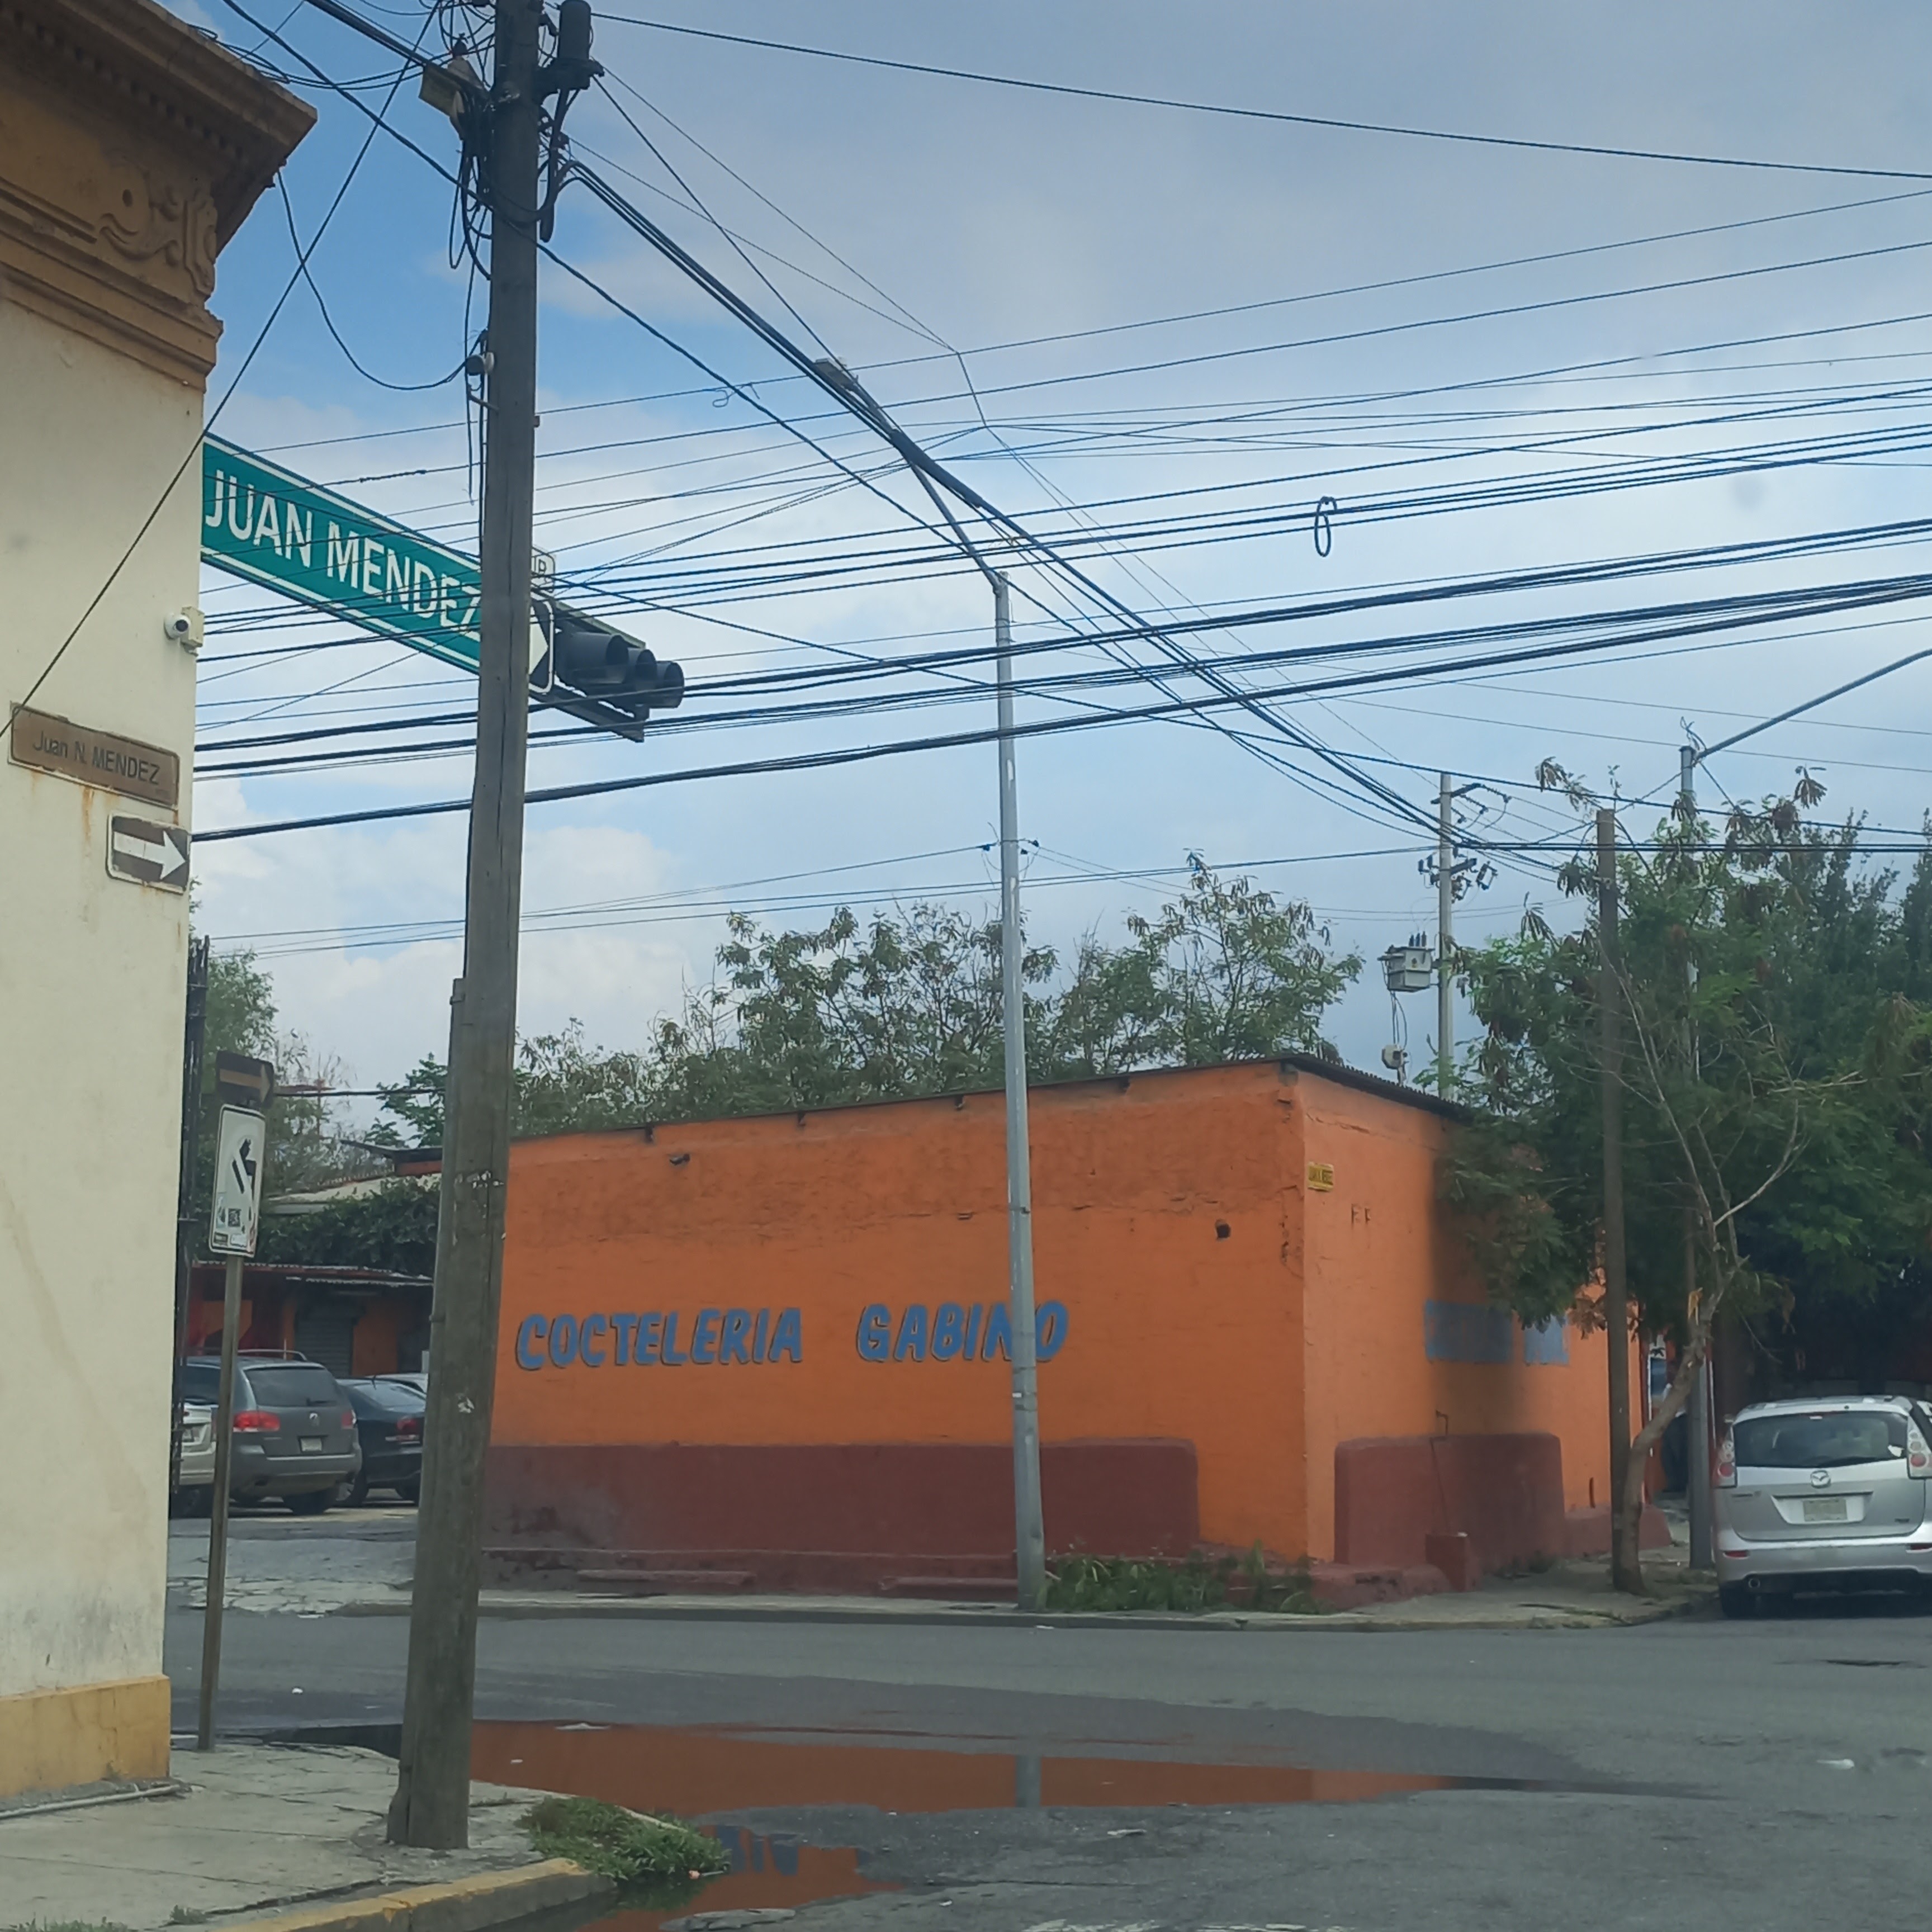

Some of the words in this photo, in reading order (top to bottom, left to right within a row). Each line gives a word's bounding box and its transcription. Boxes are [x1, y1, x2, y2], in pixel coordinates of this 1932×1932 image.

[205, 470, 312, 568] JUAN
[327, 520, 481, 631] MENDEZ
[33, 731, 68, 759] Juan
[92, 746, 160, 785] MENDEZ
[515, 1307, 803, 1371] COCTELERIA
[856, 1300, 1069, 1363] GABINO
